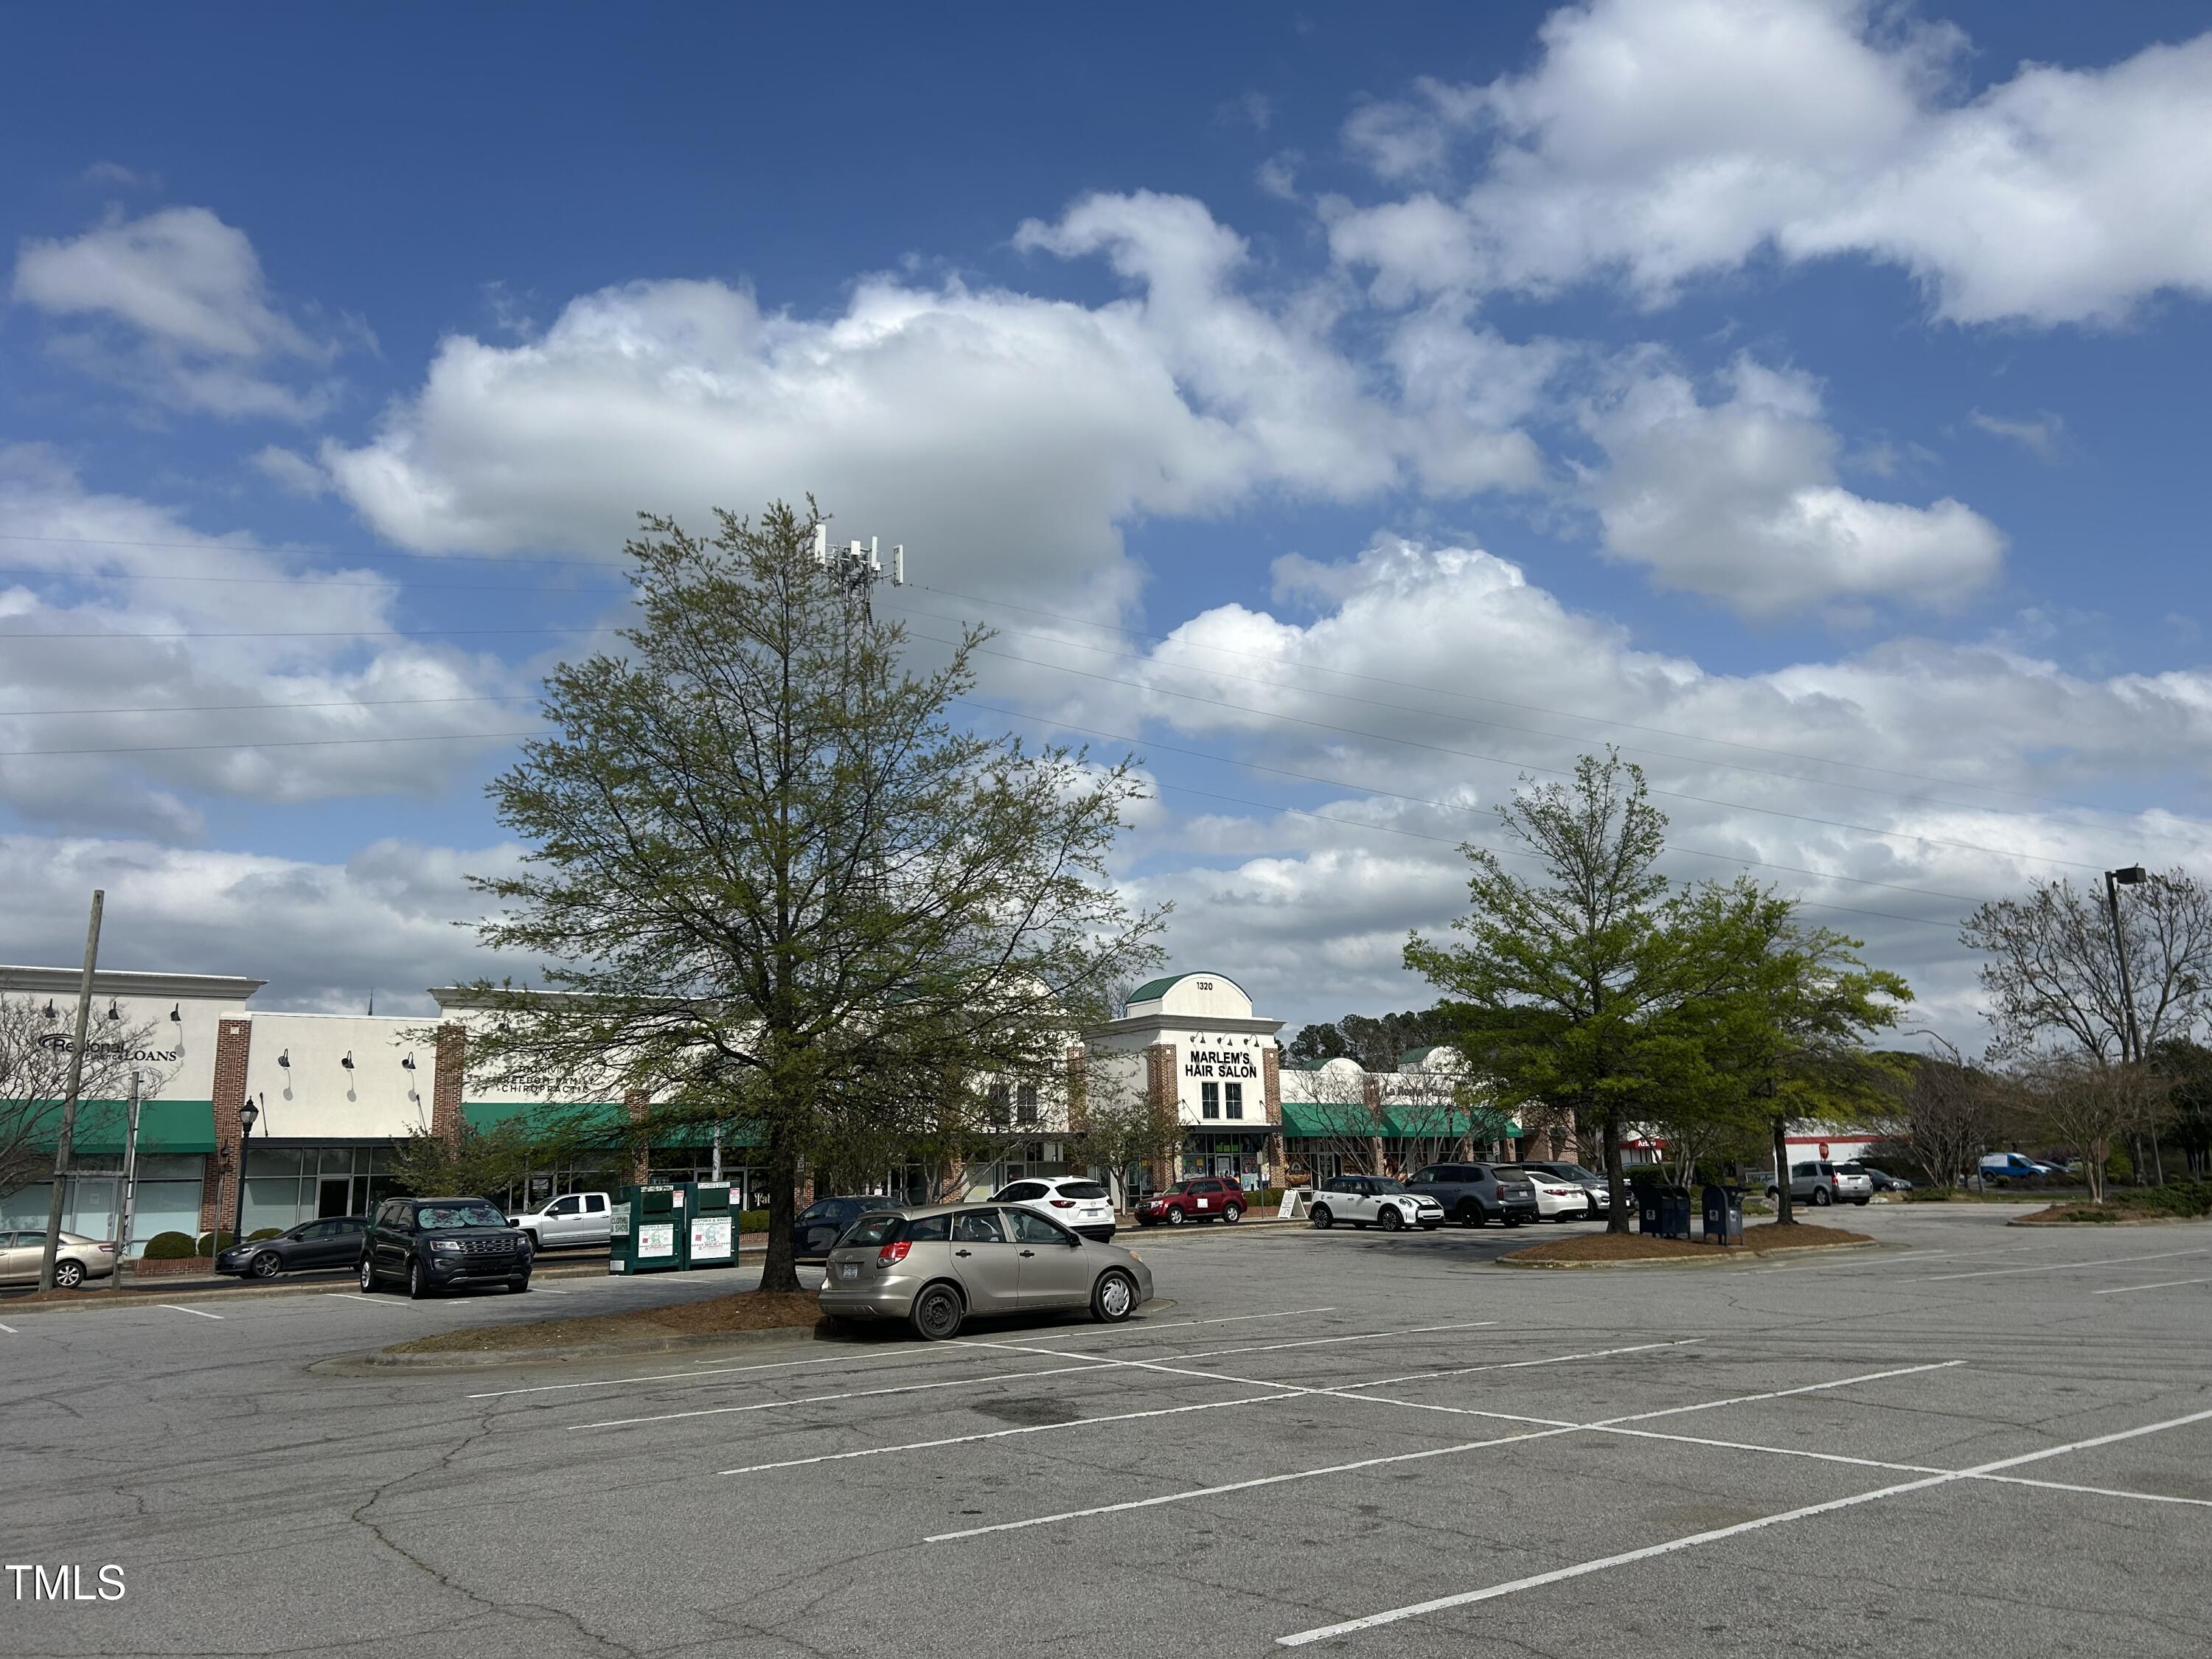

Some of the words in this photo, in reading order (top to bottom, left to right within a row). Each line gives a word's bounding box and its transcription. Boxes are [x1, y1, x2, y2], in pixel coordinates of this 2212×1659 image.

[1197, 982, 1213, 990] 1320
[53, 1039, 125, 1053] Reional
[124, 1050, 177, 1062] LOANS
[1190, 1051, 1250, 1064] MARLEM'S
[1185, 1064, 1213, 1077] HAIR
[1218, 1065, 1257, 1078] SALON
[501, 1085, 589, 1093] CHIROPRACTIC
